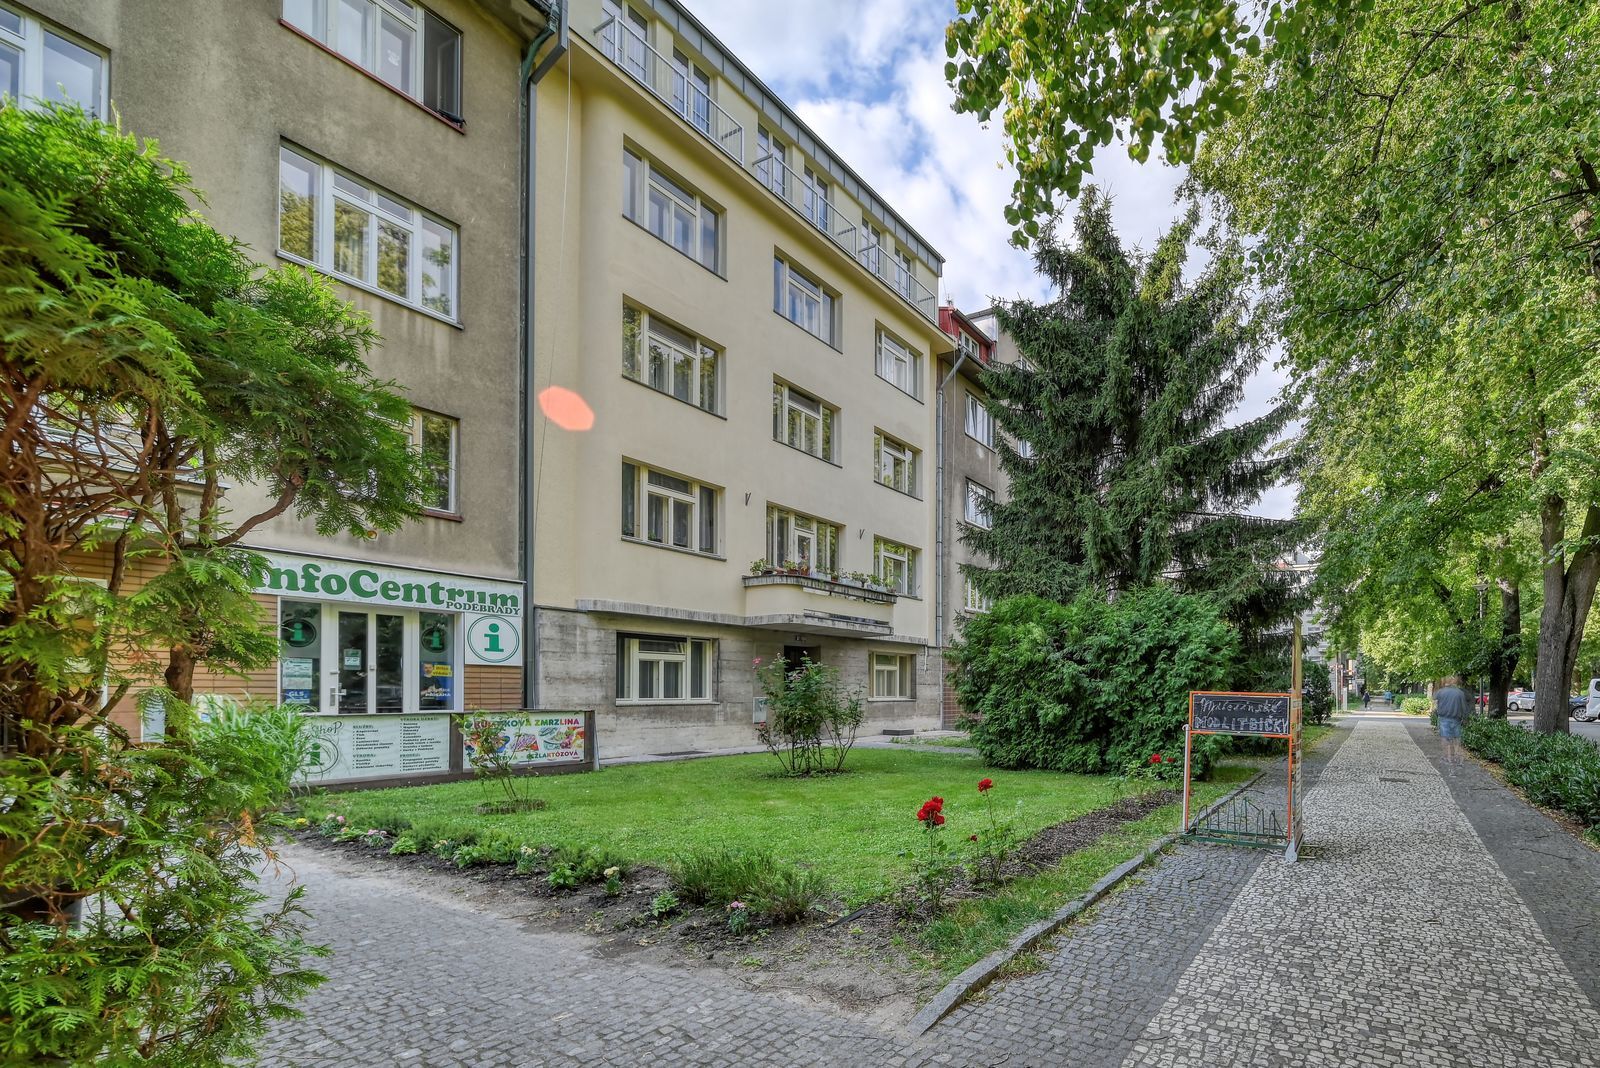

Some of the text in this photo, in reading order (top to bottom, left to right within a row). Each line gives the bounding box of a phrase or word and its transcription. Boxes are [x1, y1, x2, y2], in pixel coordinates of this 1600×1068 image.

[257, 563, 519, 608] nfoCentrum
[446, 601, 520, 615] PODĚBRADY
[534, 718, 579, 726] ZMRZLINA
